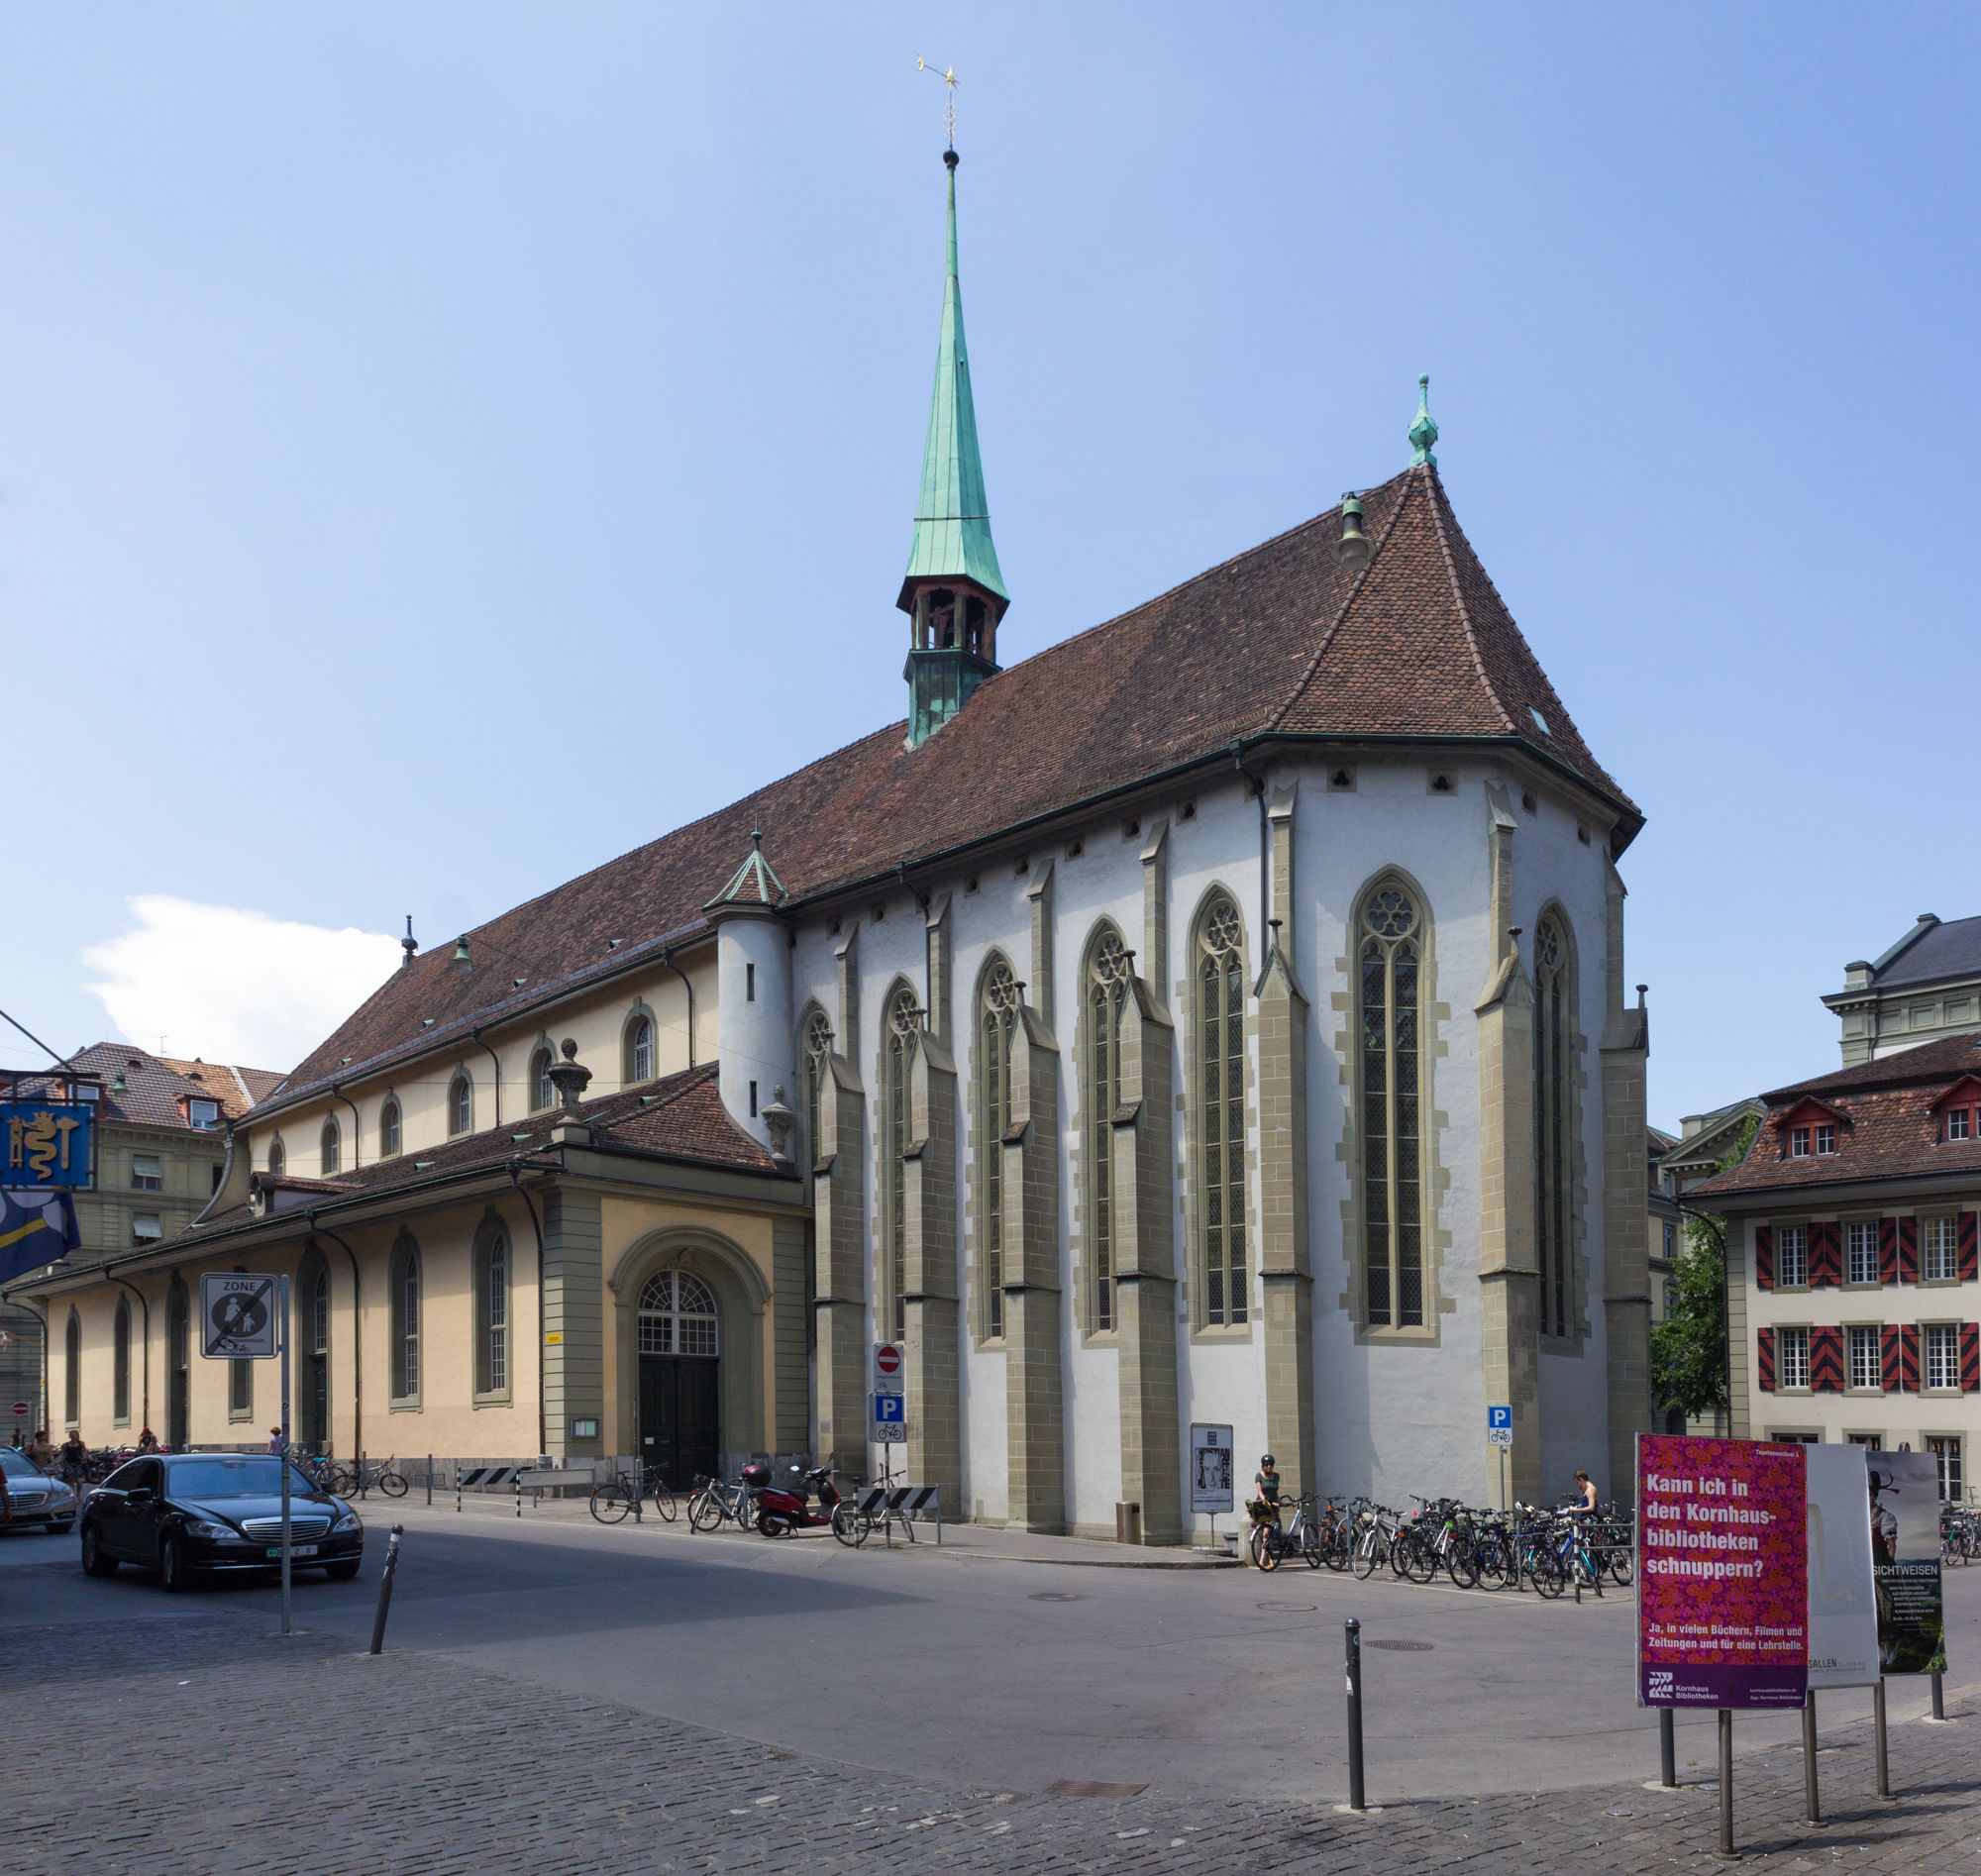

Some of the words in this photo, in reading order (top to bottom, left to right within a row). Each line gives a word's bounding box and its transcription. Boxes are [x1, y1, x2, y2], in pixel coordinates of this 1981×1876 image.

[223, 1282, 256, 1291] ZONE
[883, 1399, 897, 1419] P
[1494, 1409, 1507, 1426] P
[1646, 1474, 1693, 1494] Kann
[1699, 1477, 1726, 1496] ich
[1731, 1479, 1748, 1497] in
[1646, 1502, 1681, 1520] den
[1687, 1503, 1776, 1524] Kornhaus-
[1646, 1528, 1758, 1551] bibliotheken
[1646, 1557, 1763, 1580] schnuppern?
[1873, 1565, 1938, 1576] SICHTWEISEN
[1648, 1622, 1664, 1635] Ja,
[1666, 1623, 1677, 1633] in
[1679, 1624, 1709, 1634] vielen
[1711, 1624, 1752, 1637] Büchern,
[1755, 1625, 1784, 1635] Filmen
[1786, 1626, 1803, 1636] und
[1648, 1637, 1698, 1650] Zeitungen
[1700, 1638, 1719, 1649] und
[1720, 1638, 1734, 1649] für
[1736, 1640, 1756, 1649] eine
[1758, 1640, 1804, 1650] Lehrstelle.
[1675, 1692, 1720, 1701] Bibliotheken
